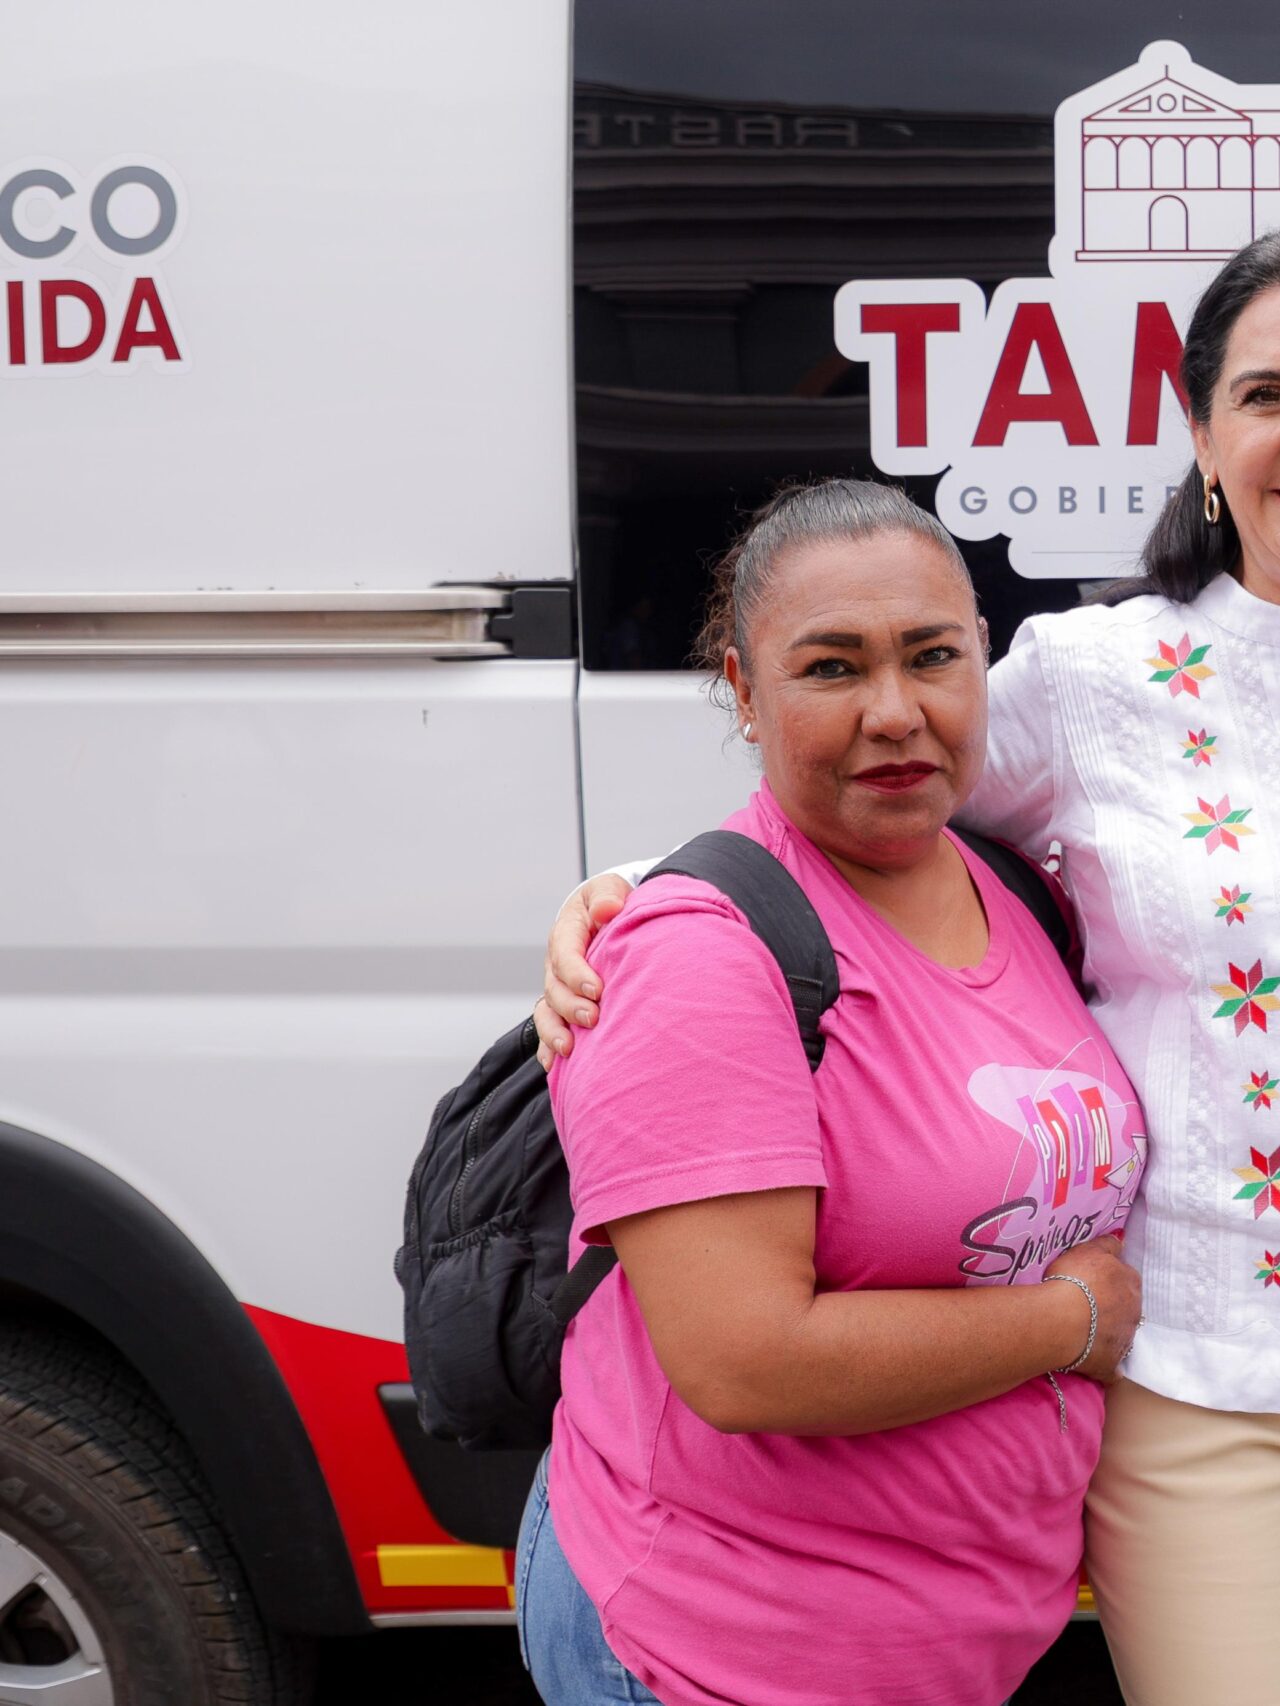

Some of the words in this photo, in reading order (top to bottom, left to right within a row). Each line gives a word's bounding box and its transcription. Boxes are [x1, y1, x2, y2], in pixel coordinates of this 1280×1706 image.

[6, 277, 182, 365] IDA
[959, 485, 1178, 515] GOBIE
[958, 1196, 1102, 1285] Springs
